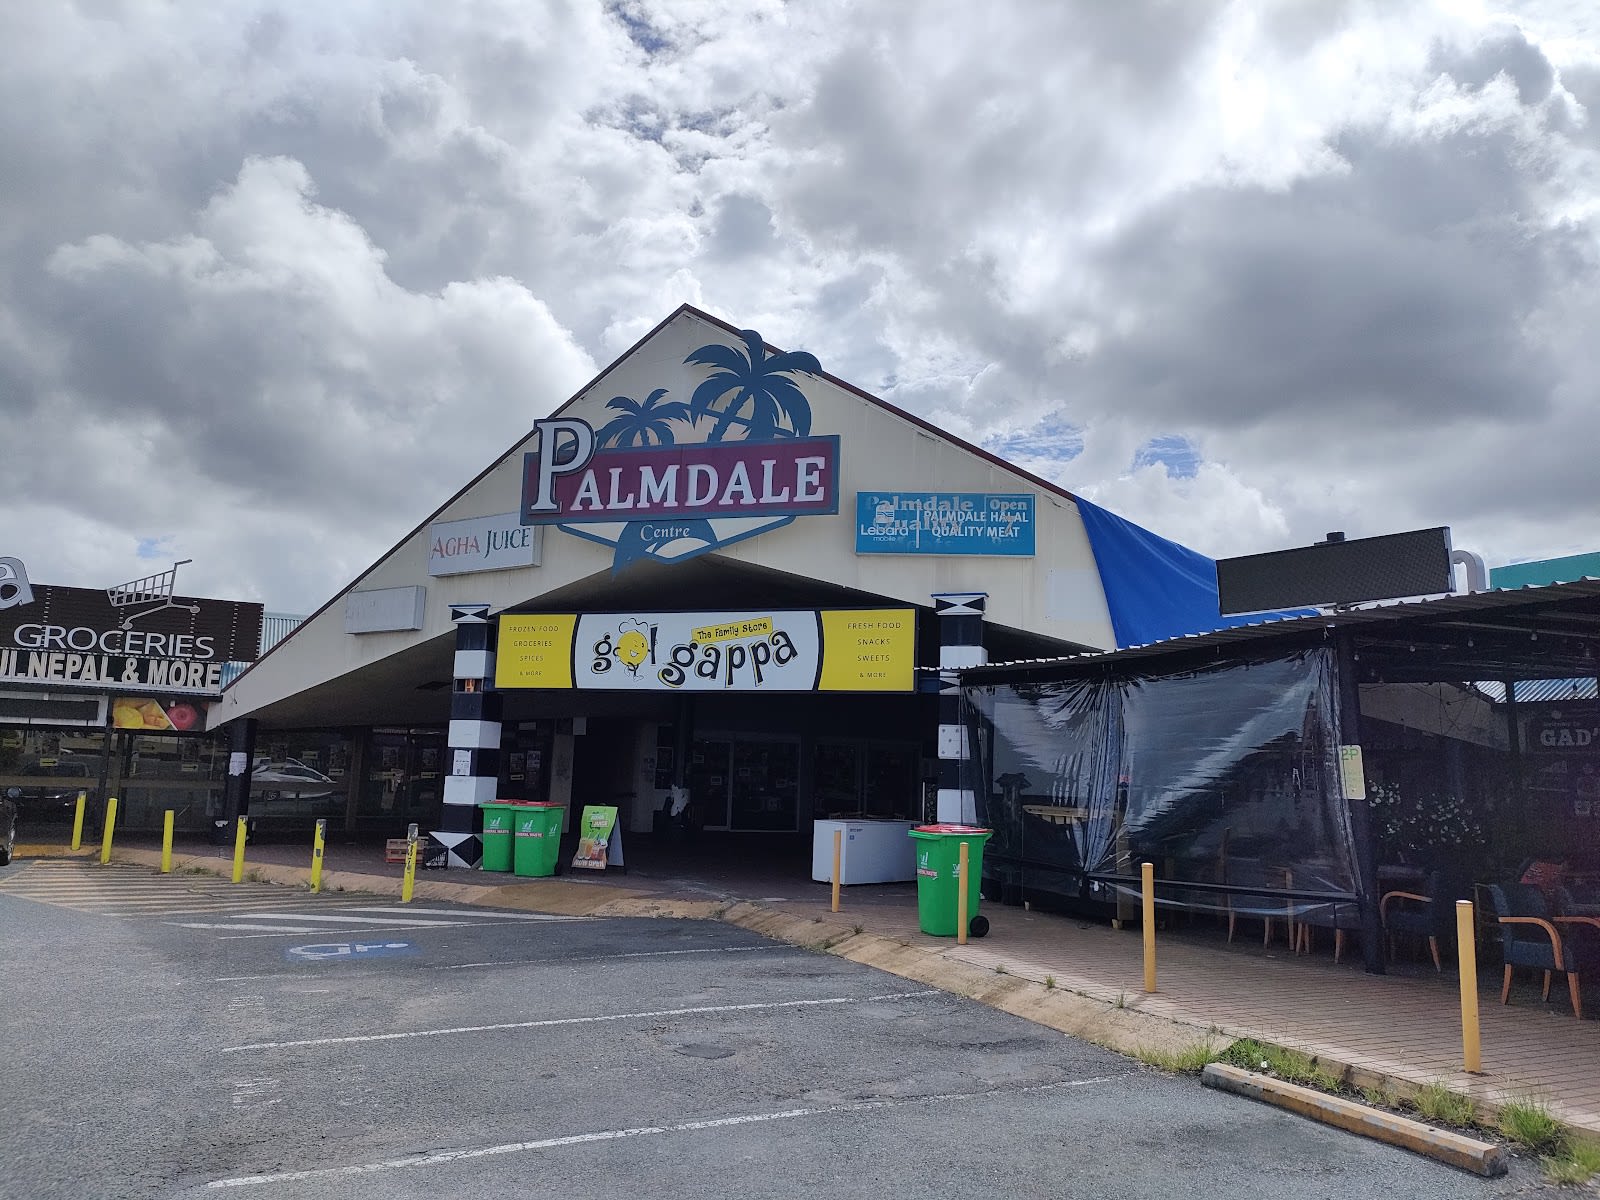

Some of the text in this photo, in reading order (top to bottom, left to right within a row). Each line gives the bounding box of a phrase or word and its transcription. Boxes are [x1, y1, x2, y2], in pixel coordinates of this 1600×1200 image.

[529, 417, 825, 512] PALMDALE
[924, 511, 1029, 522] PALMDALE HALAL
[431, 528, 531, 559] AGHA JUICE
[640, 525, 690, 541] Centre
[932, 526, 1020, 538] QUALITY MEAT
[13, 623, 215, 659] GROCERIES
[697, 622, 768, 639] The Family Store
[657, 629, 798, 688] gappa
[121, 657, 140, 684] &
[147, 659, 221, 688] MORE
[1342, 748, 1358, 760] 2P
